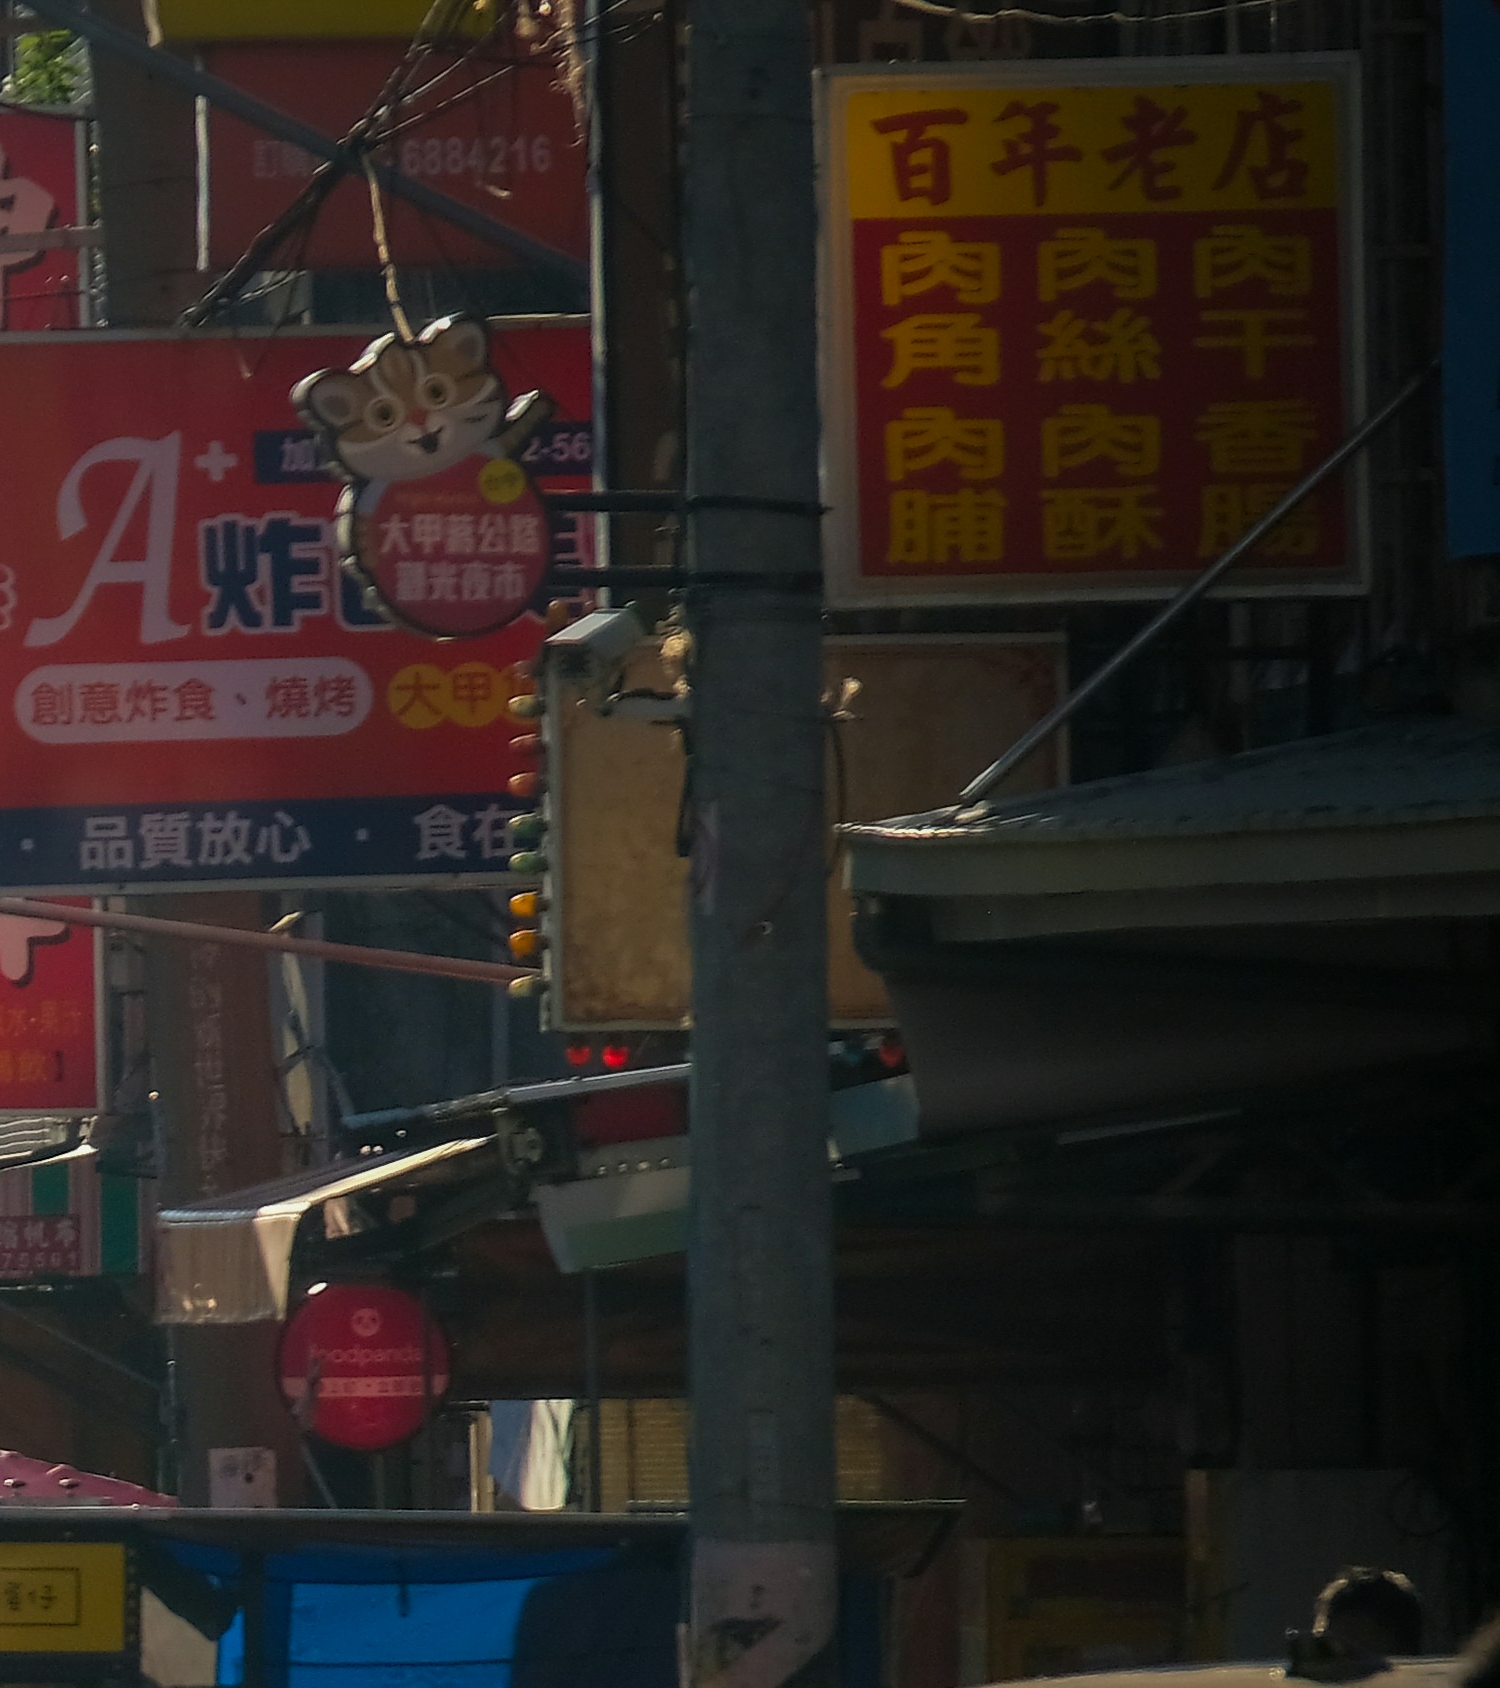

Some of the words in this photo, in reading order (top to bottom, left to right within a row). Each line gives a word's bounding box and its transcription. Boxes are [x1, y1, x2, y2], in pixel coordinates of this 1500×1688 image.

[870, 91, 1310, 206] 百年老店
[30, 676, 357, 726] 創意炸食、燒烤
[80, 810, 311, 870] 品質放心
